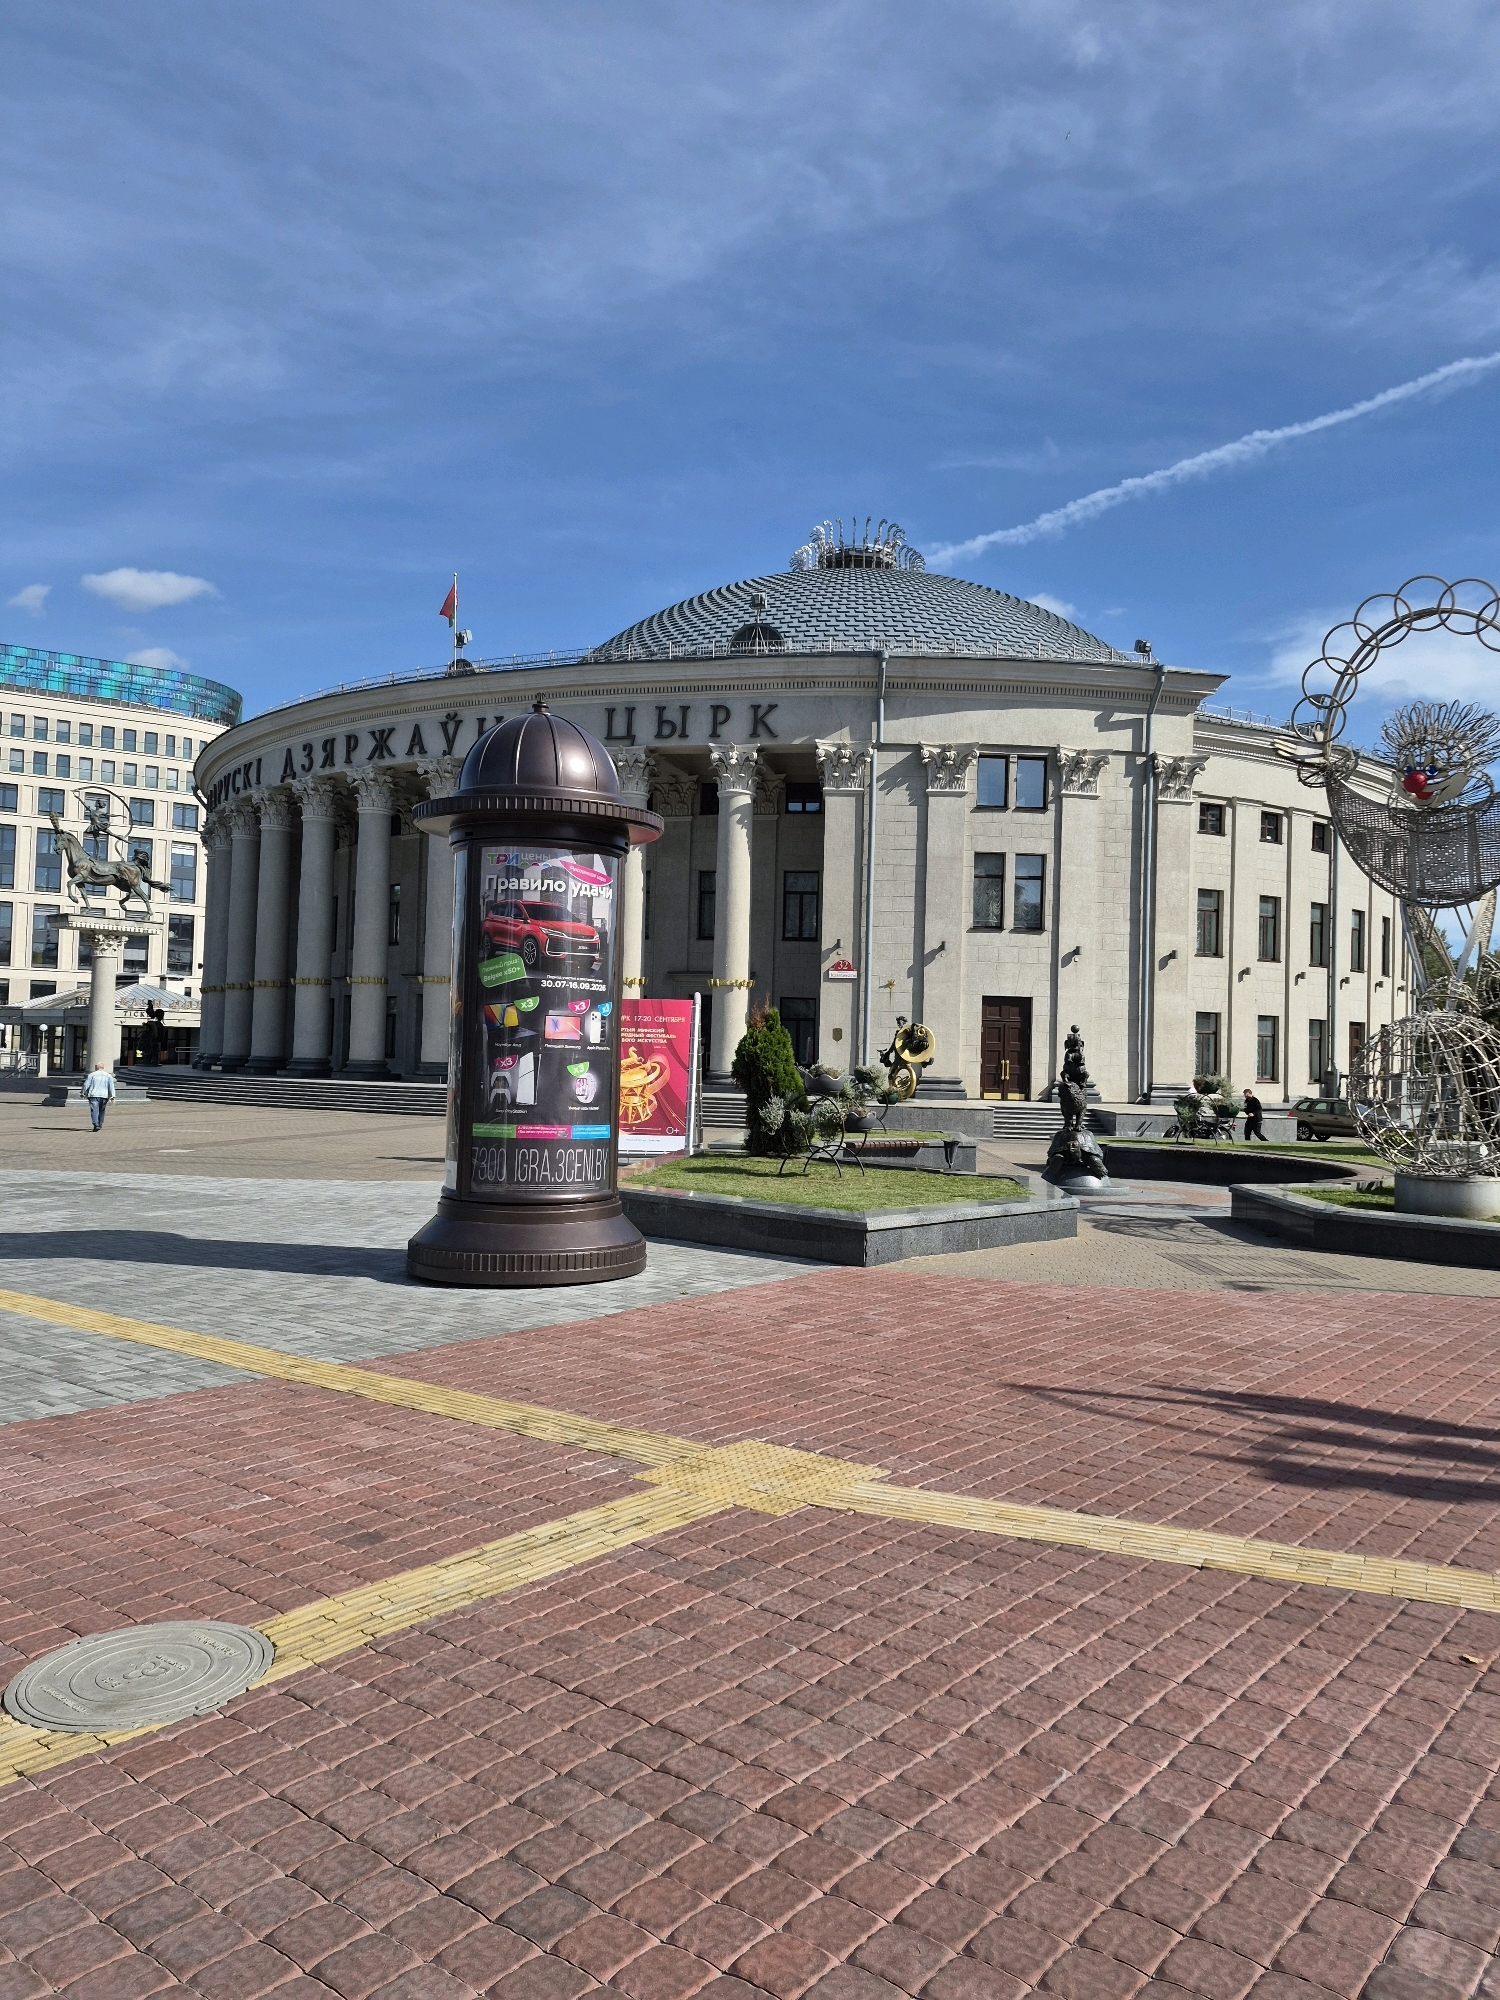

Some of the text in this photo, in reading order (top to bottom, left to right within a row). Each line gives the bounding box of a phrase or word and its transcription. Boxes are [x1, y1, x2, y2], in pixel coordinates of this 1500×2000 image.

[604, 704, 779, 746] ЦЫРК
[487, 853, 551, 866] ТРИ цены
[486, 874, 613, 900] Правило удачи
[837, 960, 849, 970] 32
[483, 971, 503, 983] Belgee
[521, 999, 534, 1009] x3
[574, 1001, 586, 1011] x3
[500, 1057, 513, 1067] x3
[572, 1063, 585, 1073] x3
[471, 1146, 609, 1183] 7300 IGRA.3CENI.BY
